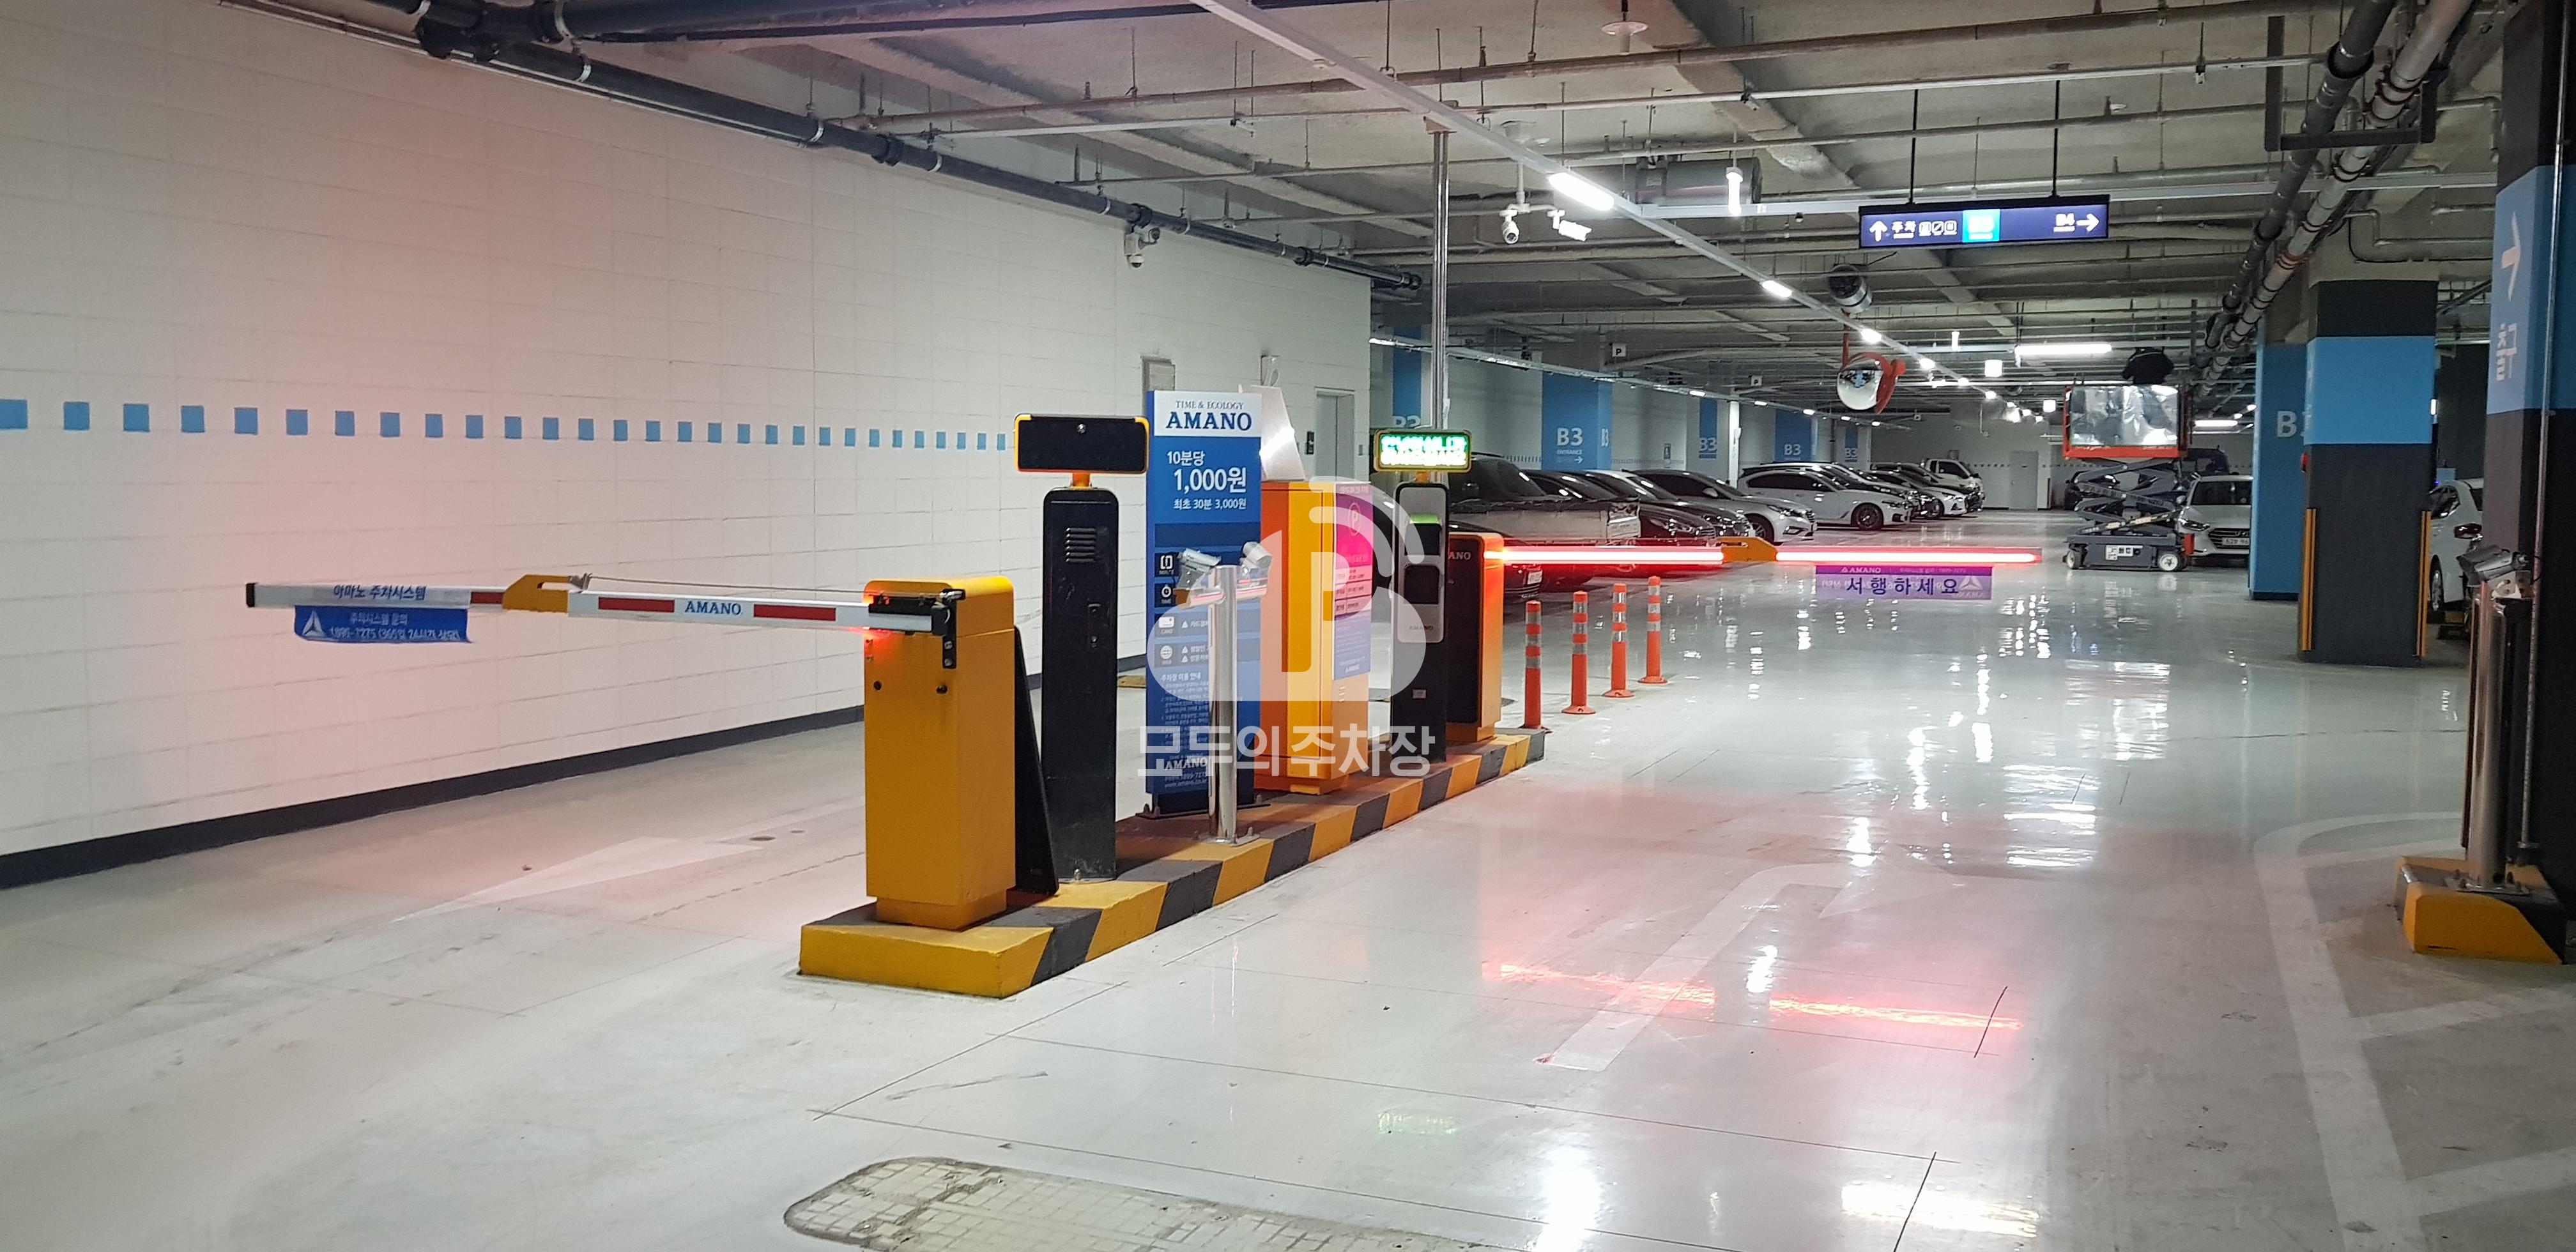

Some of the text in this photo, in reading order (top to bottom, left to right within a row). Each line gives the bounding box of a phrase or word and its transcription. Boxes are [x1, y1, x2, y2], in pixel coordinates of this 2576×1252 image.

[1176, 400, 1244, 410] TIME & ECOLOGY
[1165, 411, 1253, 431] AMANO
[2276, 410, 2306, 437] B
[1556, 427, 1583, 446] B3
[1699, 438, 1717, 452] B3
[1784, 443, 1802, 456] B3
[1167, 450, 1206, 467] 10분당
[1844, 447, 1858, 458] B3
[1174, 467, 1246, 495] 1,000원
[1173, 498, 1246, 510] 최초 30분 3,000원
[1448, 551, 1471, 560] ANO
[334, 585, 366, 599] 아마노
[1846, 577, 1959, 595] 서행하세요
[684, 601, 741, 615] AMANO
[1165, 757, 1208, 770] AMANO
